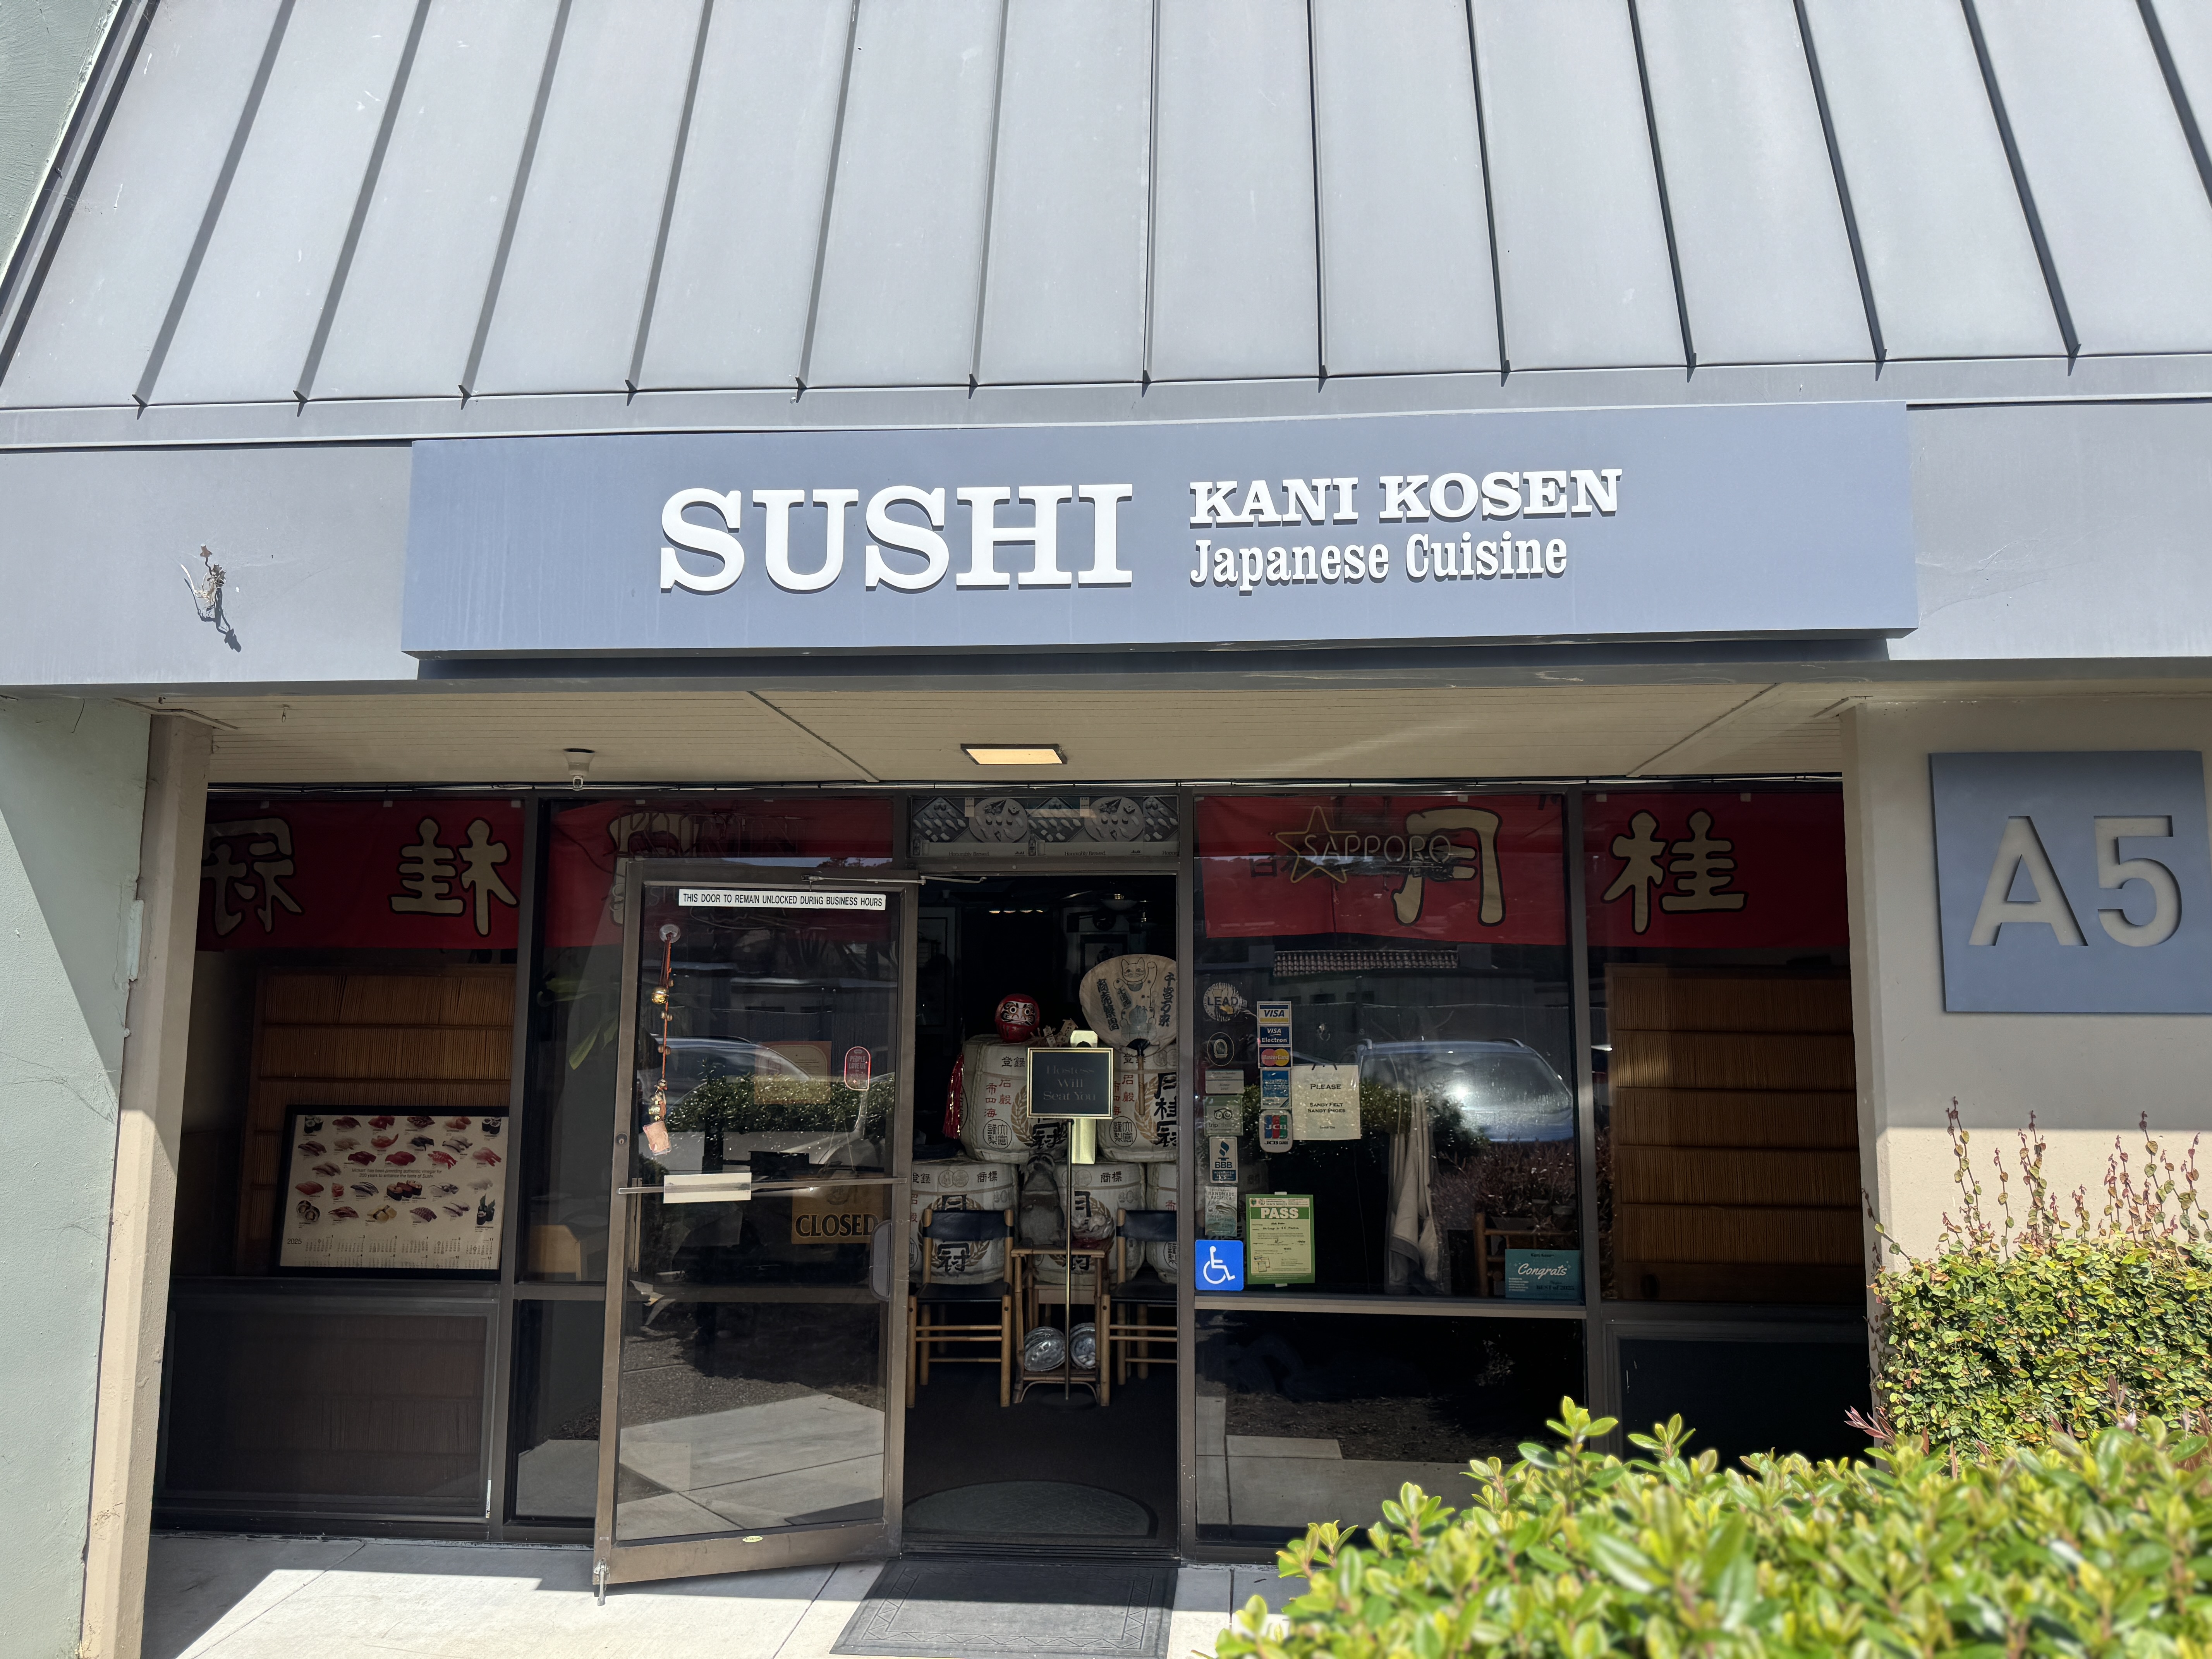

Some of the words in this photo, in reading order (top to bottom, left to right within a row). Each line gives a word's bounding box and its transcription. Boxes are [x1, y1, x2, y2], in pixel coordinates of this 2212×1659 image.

[1189, 477, 1359, 525] KANI
[1379, 468, 1623, 520] KOSEN
[659, 483, 1133, 593] SUSHI
[1189, 539, 1389, 592] Japanese
[1405, 531, 1568, 579] Cuisine
[1304, 834, 1451, 863] SAPPORO
[1968, 815, 2183, 946] A5
[683, 893, 698, 903] THIS
[701, 894, 721, 903] DOOR
[723, 894, 732, 904] TO
[735, 895, 760, 904] REMAIN
[762, 895, 798, 905] UNLOCKED
[800, 896, 824, 905] DURING
[826, 896, 858, 906] BUSINESS
[860, 897, 883, 907] HOURS
[1207, 996, 1239, 1006] LEAD
[1001, 1056, 1026, 1068] 登録
[1047, 1065, 1095, 1075] Hostess
[1057, 1078, 1084, 1088] Will
[1043, 1091, 1070, 1101] Seat
[1073, 1091, 1096, 1101] You
[976, 1170, 998, 1183] 商標
[1101, 1171, 1122, 1183] 商標
[1261, 1207, 1299, 1219] PASS
[795, 1214, 879, 1237] CLOSED
[1517, 1262, 1568, 1280] Congrats
